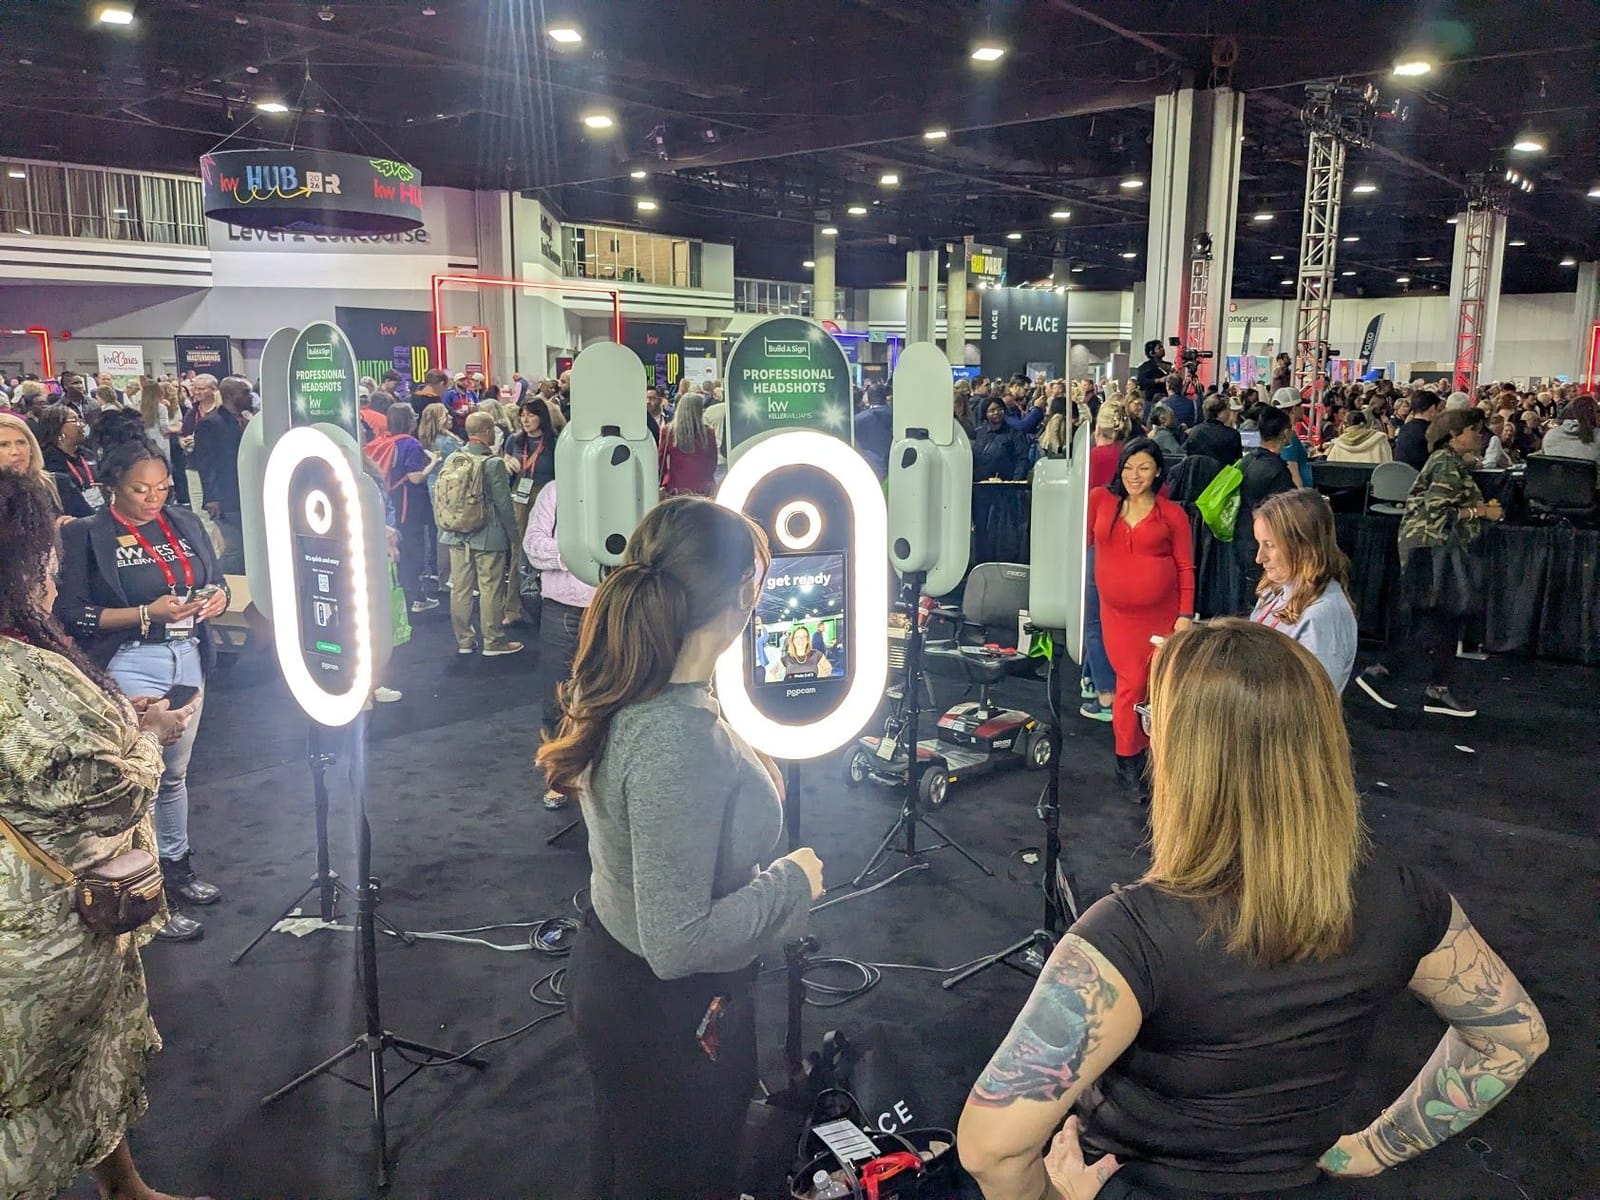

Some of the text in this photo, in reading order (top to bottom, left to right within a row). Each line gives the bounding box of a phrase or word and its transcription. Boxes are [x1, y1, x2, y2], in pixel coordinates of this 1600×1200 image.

[220, 165, 298, 193] kw HUB
[373, 177, 395, 199] kw
[380, 322, 398, 336] kw
[1019, 314, 1060, 333] PLACE
[646, 333, 660, 345] kw
[411, 346, 429, 384] UP
[667, 353, 679, 385] UP
[296, 369, 347, 381] PROFESSIONAL
[743, 368, 835, 380] PROFESSIONAL
[301, 381, 342, 392] HEADSHOTS
[753, 382, 826, 393] HEADSHOTS
[309, 395, 321, 409] kw
[768, 396, 789, 412] kw
[767, 572, 831, 590] get ready
